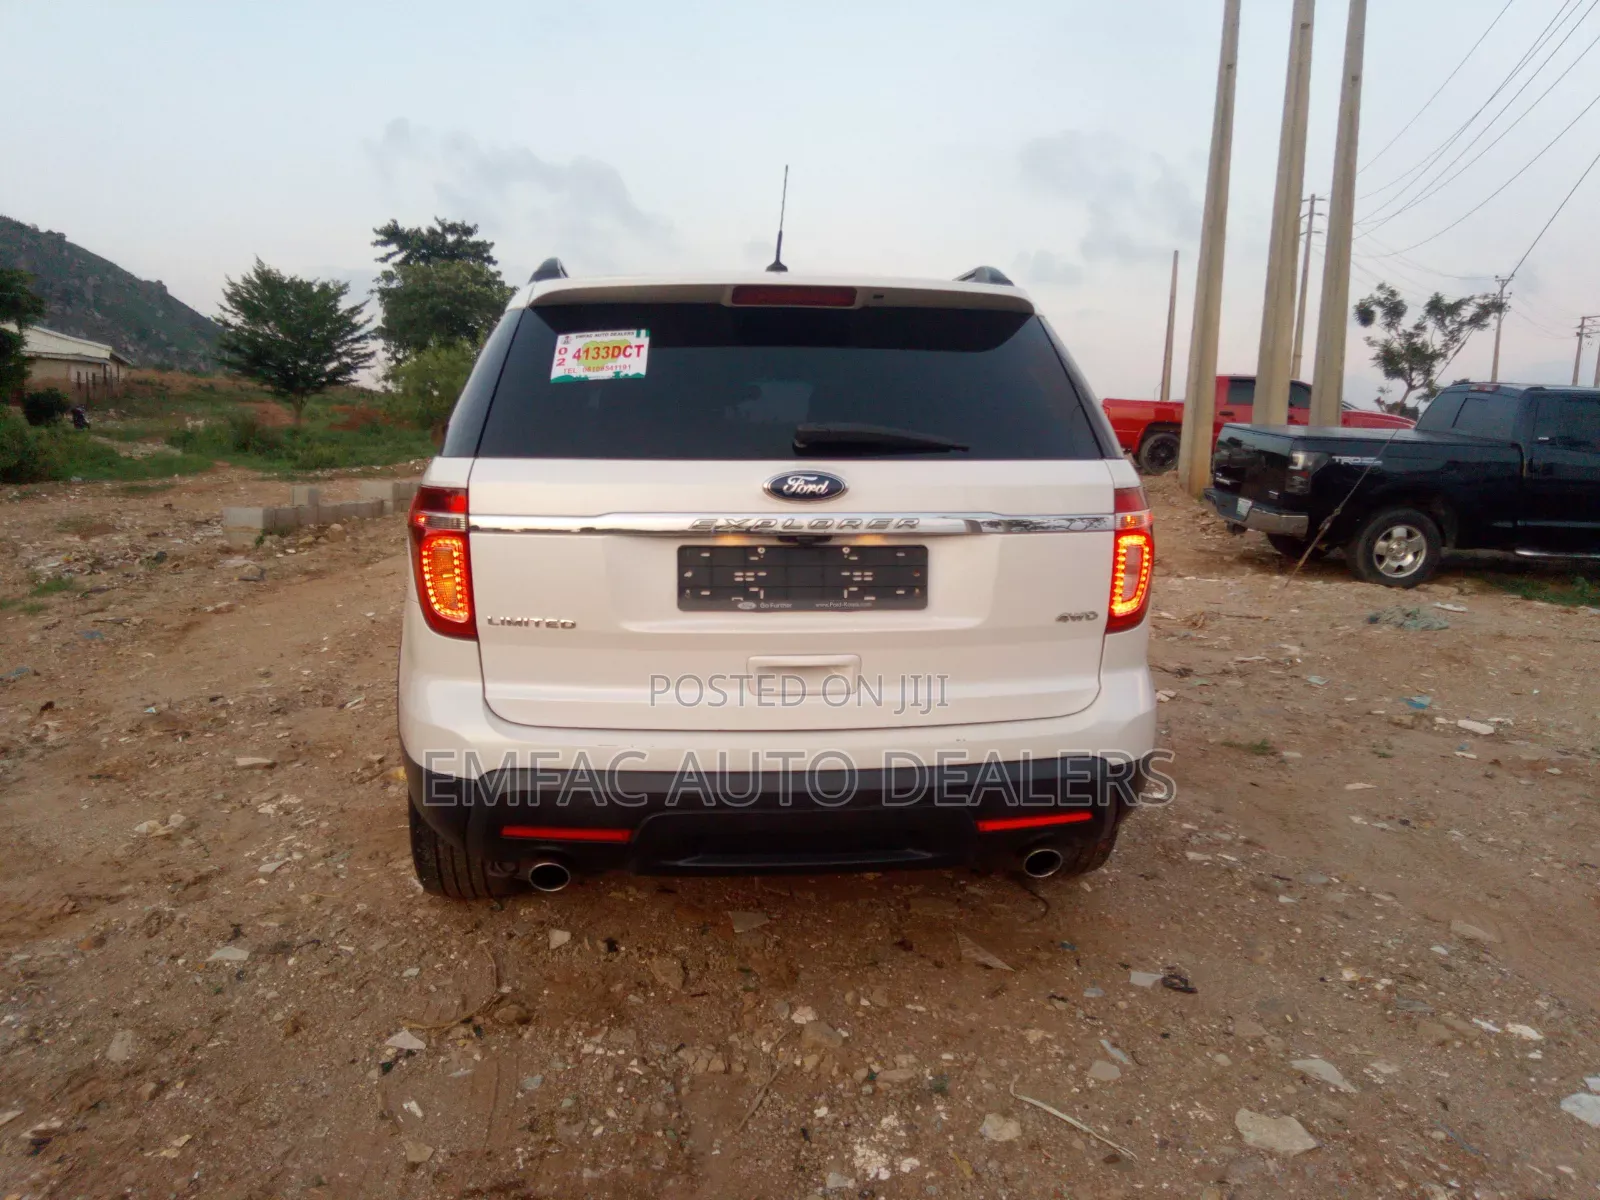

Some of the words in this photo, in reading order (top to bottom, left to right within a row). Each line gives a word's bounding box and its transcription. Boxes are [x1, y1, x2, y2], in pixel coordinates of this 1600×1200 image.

[572, 344, 645, 361] 4133DCT
[783, 475, 828, 495] Ford
[687, 518, 921, 531] EXPLORER
[487, 615, 577, 629] LIMITED
[1055, 610, 1099, 623] 4WD
